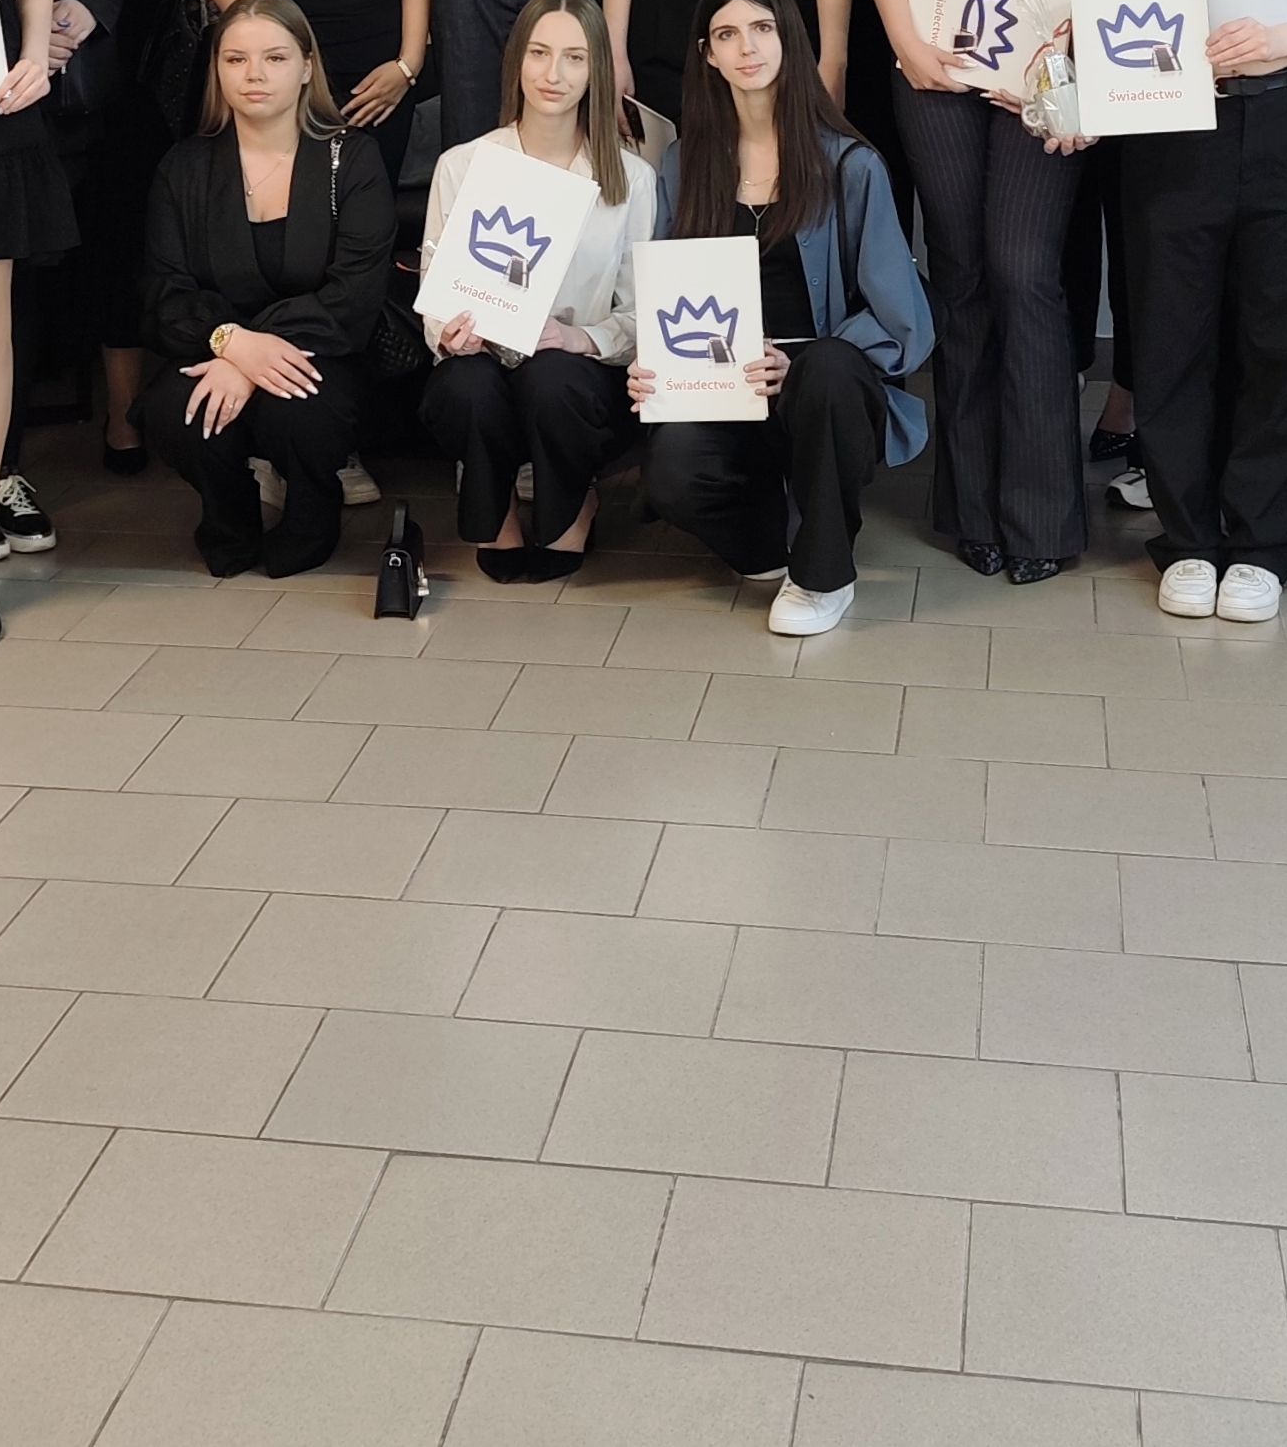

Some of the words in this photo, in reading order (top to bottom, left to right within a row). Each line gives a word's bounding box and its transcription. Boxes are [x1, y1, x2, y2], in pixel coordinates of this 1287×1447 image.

[1107, 88, 1183, 102] Świadectwo
[451, 277, 519, 313] Świadectwo
[665, 377, 736, 391] Świadectwo
